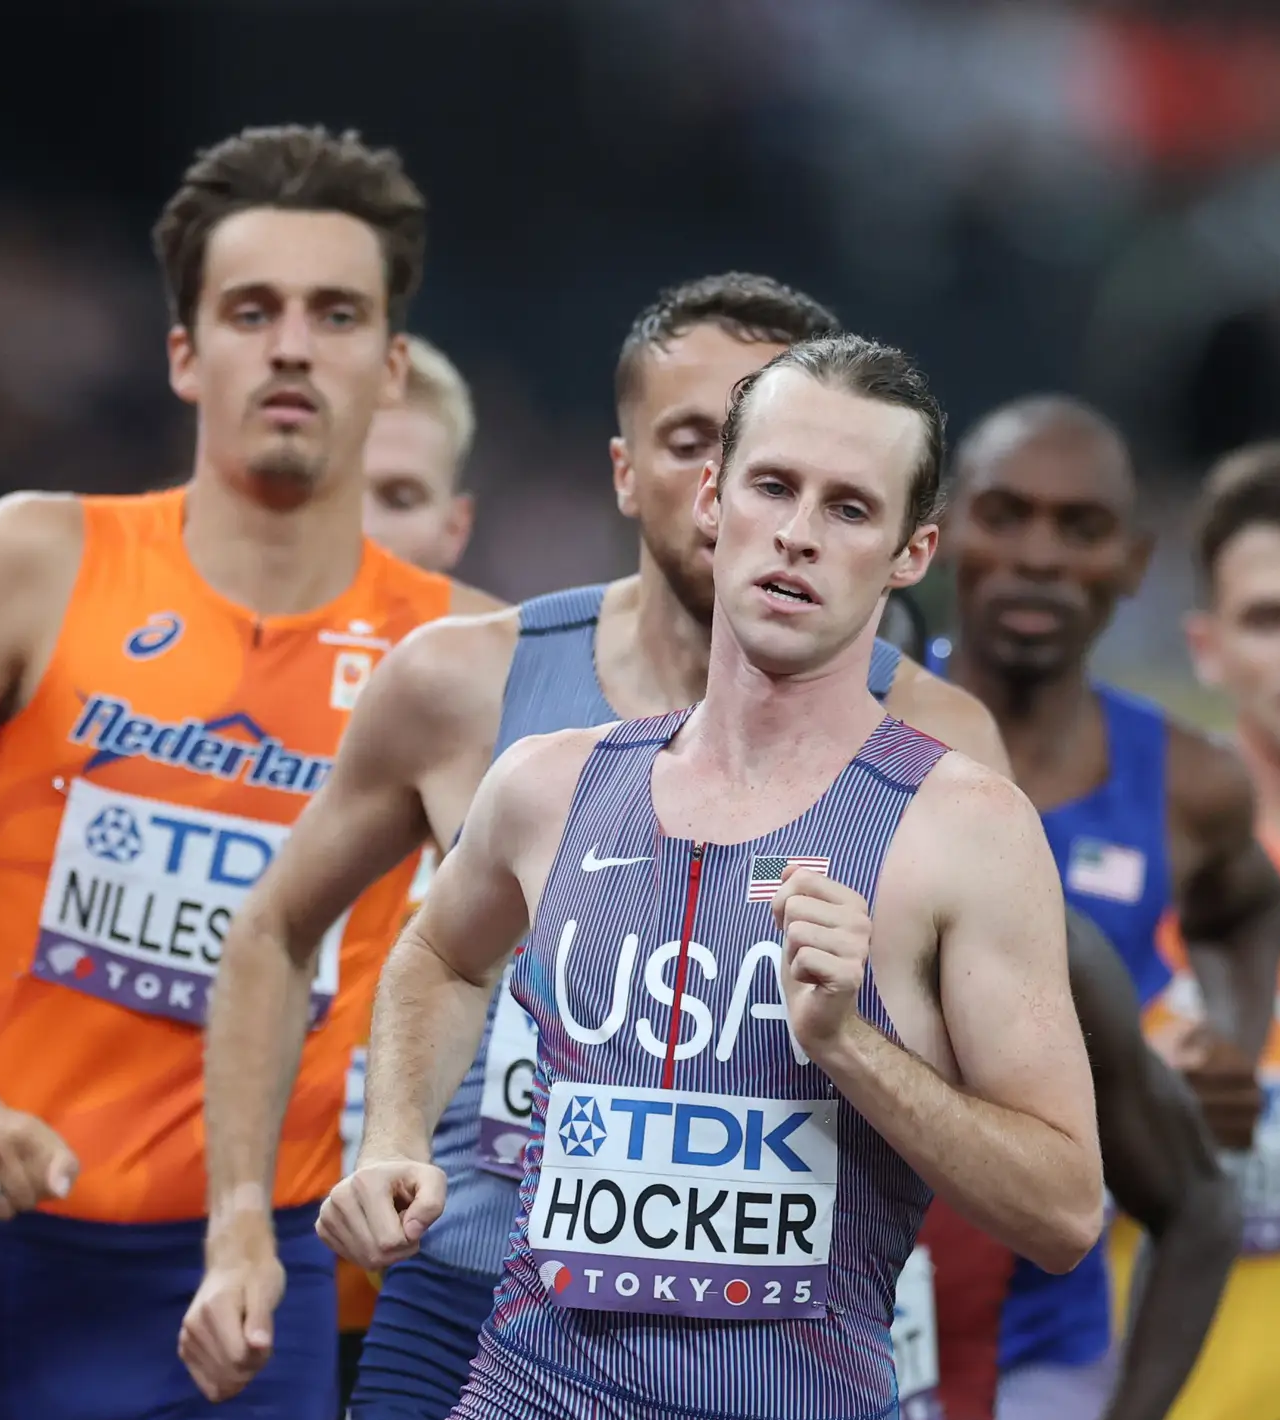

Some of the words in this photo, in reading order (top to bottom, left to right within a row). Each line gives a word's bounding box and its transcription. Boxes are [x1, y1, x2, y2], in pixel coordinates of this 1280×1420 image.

[555, 919, 811, 1065] USA
[609, 1098, 814, 1173] TDK
[542, 1177, 817, 1256] HOCKER
[762, 1280, 813, 1305] 25
